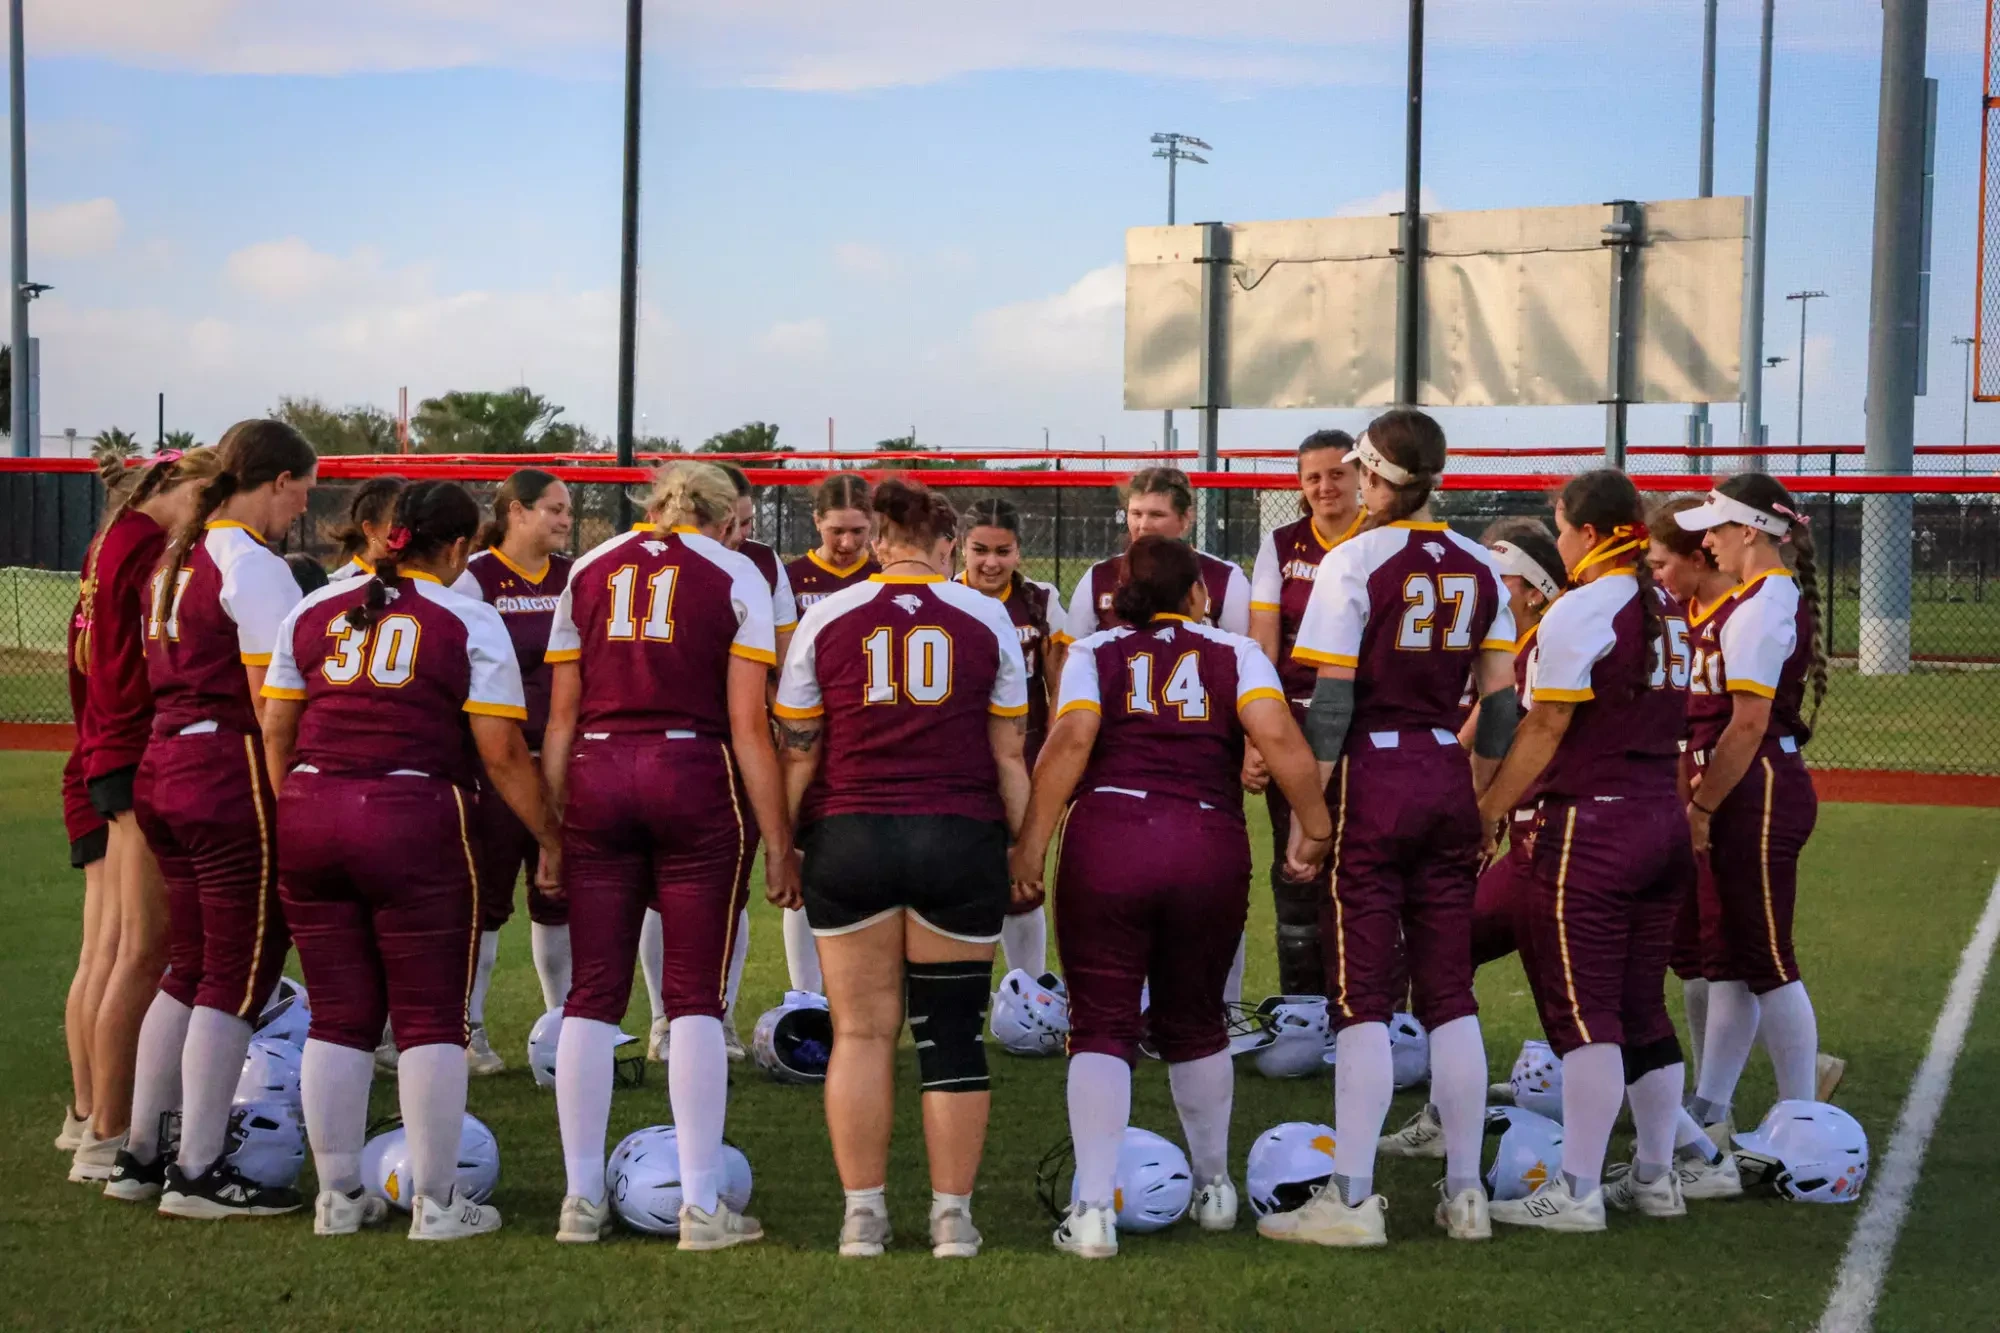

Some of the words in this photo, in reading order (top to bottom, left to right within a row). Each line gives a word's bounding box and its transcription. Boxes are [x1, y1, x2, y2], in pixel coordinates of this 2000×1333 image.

[148, 565, 195, 642] 17
[607, 564, 680, 643] 11
[1395, 573, 1479, 651] 27
[321, 611, 422, 689] 30
[862, 626, 953, 706] 10
[1127, 650, 1210, 721] 14
[1523, 1197, 1560, 1218] N
